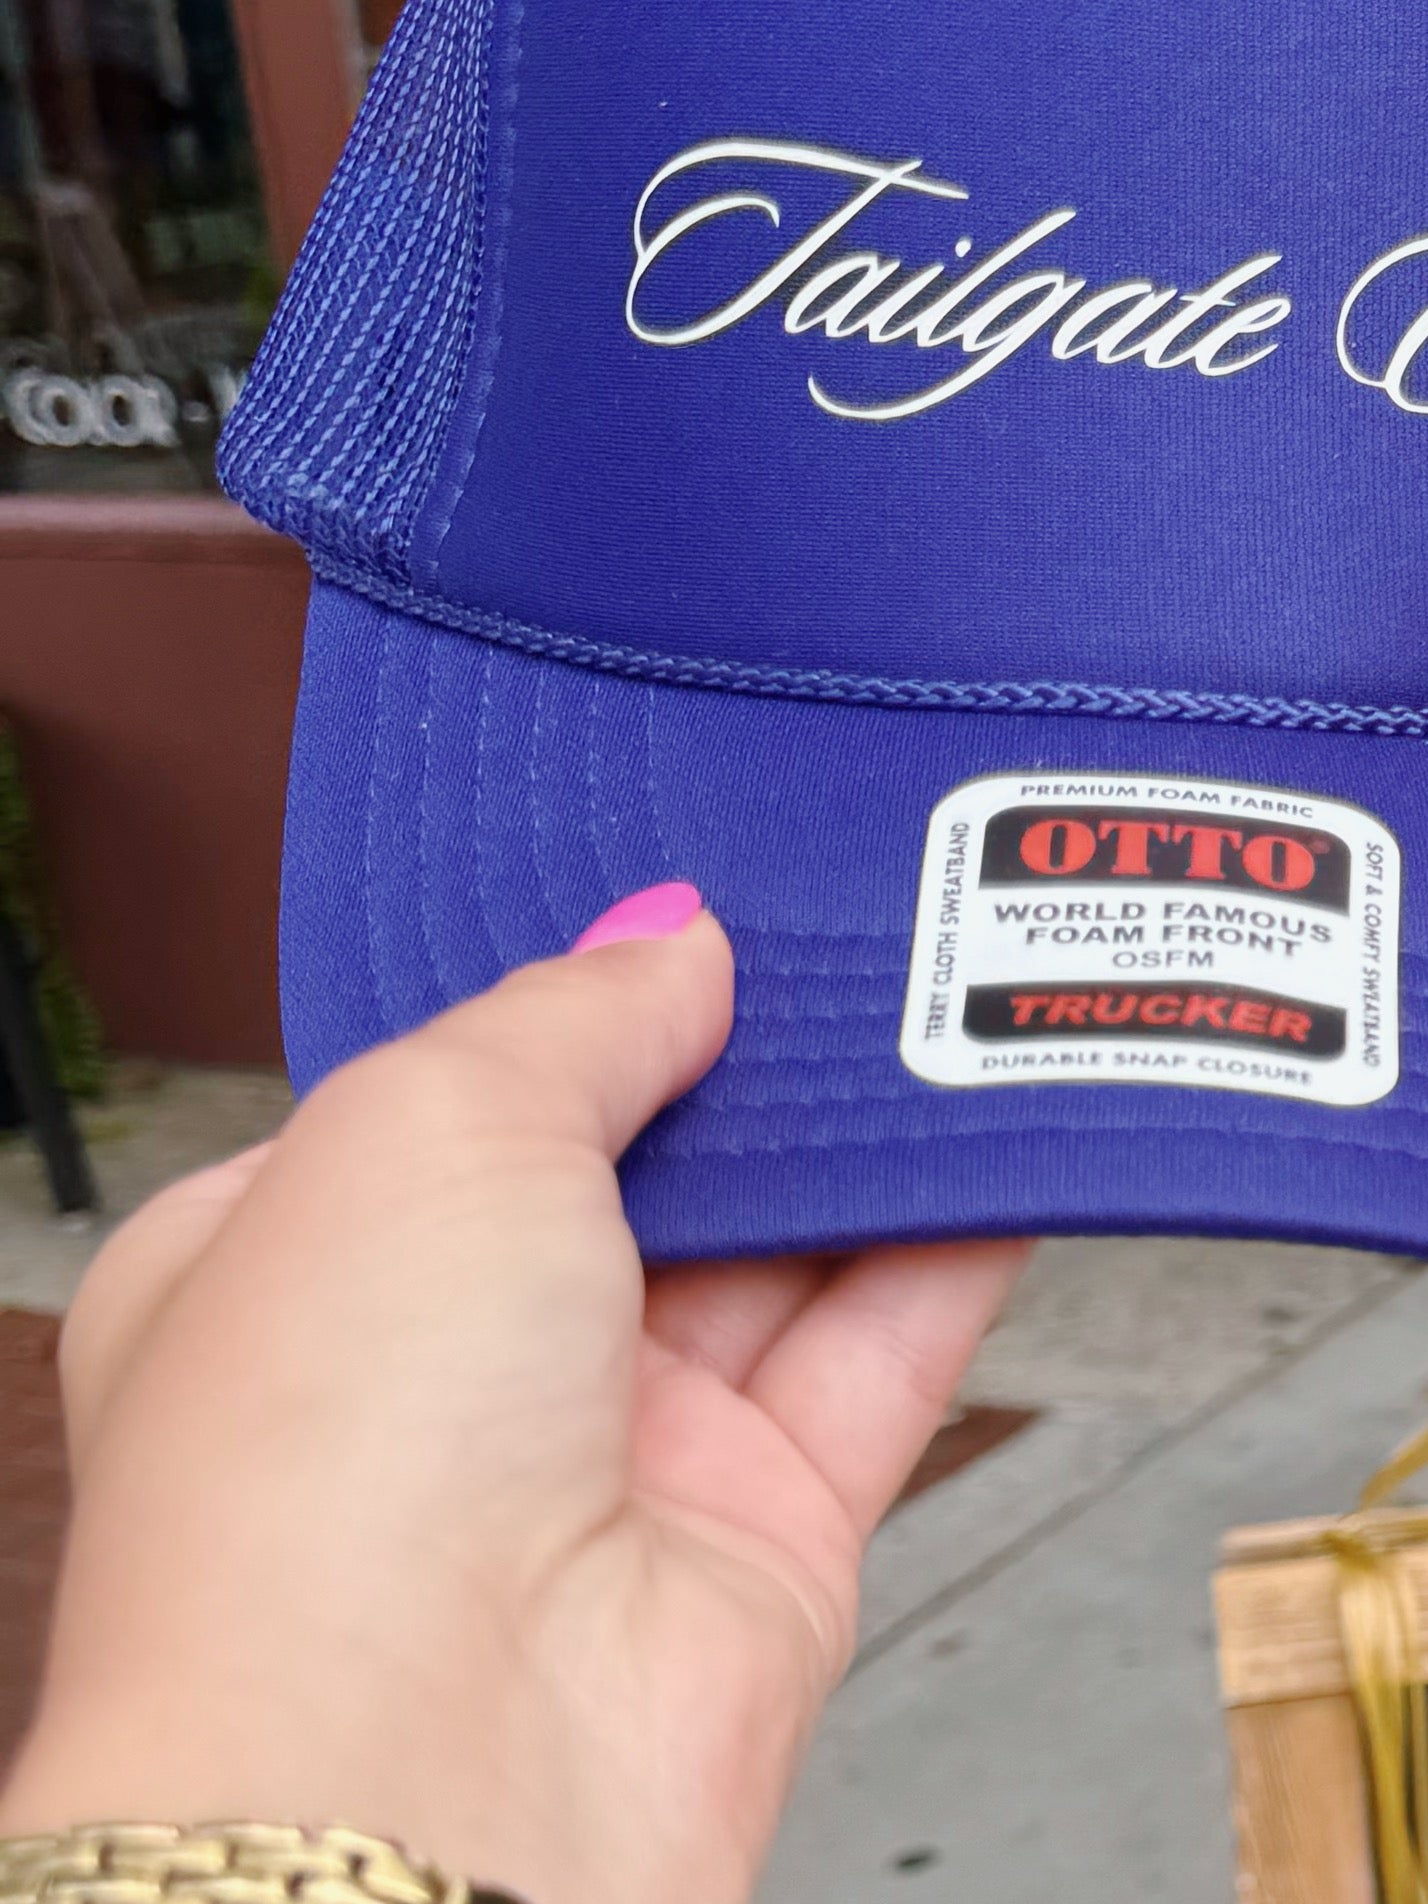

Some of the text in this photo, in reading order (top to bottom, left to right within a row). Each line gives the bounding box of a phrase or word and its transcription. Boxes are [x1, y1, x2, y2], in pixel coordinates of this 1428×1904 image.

[626, 137, 1292, 421] Tailgate
[1020, 783, 1315, 819] PREMIUM FOAM FABRIC
[1019, 818, 1316, 892] OTTO
[1365, 841, 1385, 881] SOFT
[924, 820, 970, 1041] TERRY CLOTH SWEATBAND
[994, 901, 1333, 945] WORLD FAMOUS
[1025, 924, 1303, 957] FOAM FRONT
[1363, 902, 1382, 963] COMFY
[1111, 950, 1215, 969] OSFM
[1009, 992, 1313, 1043] TRUCKER
[981, 1051, 1313, 1086] DURABLE SNAP CLOSURE
